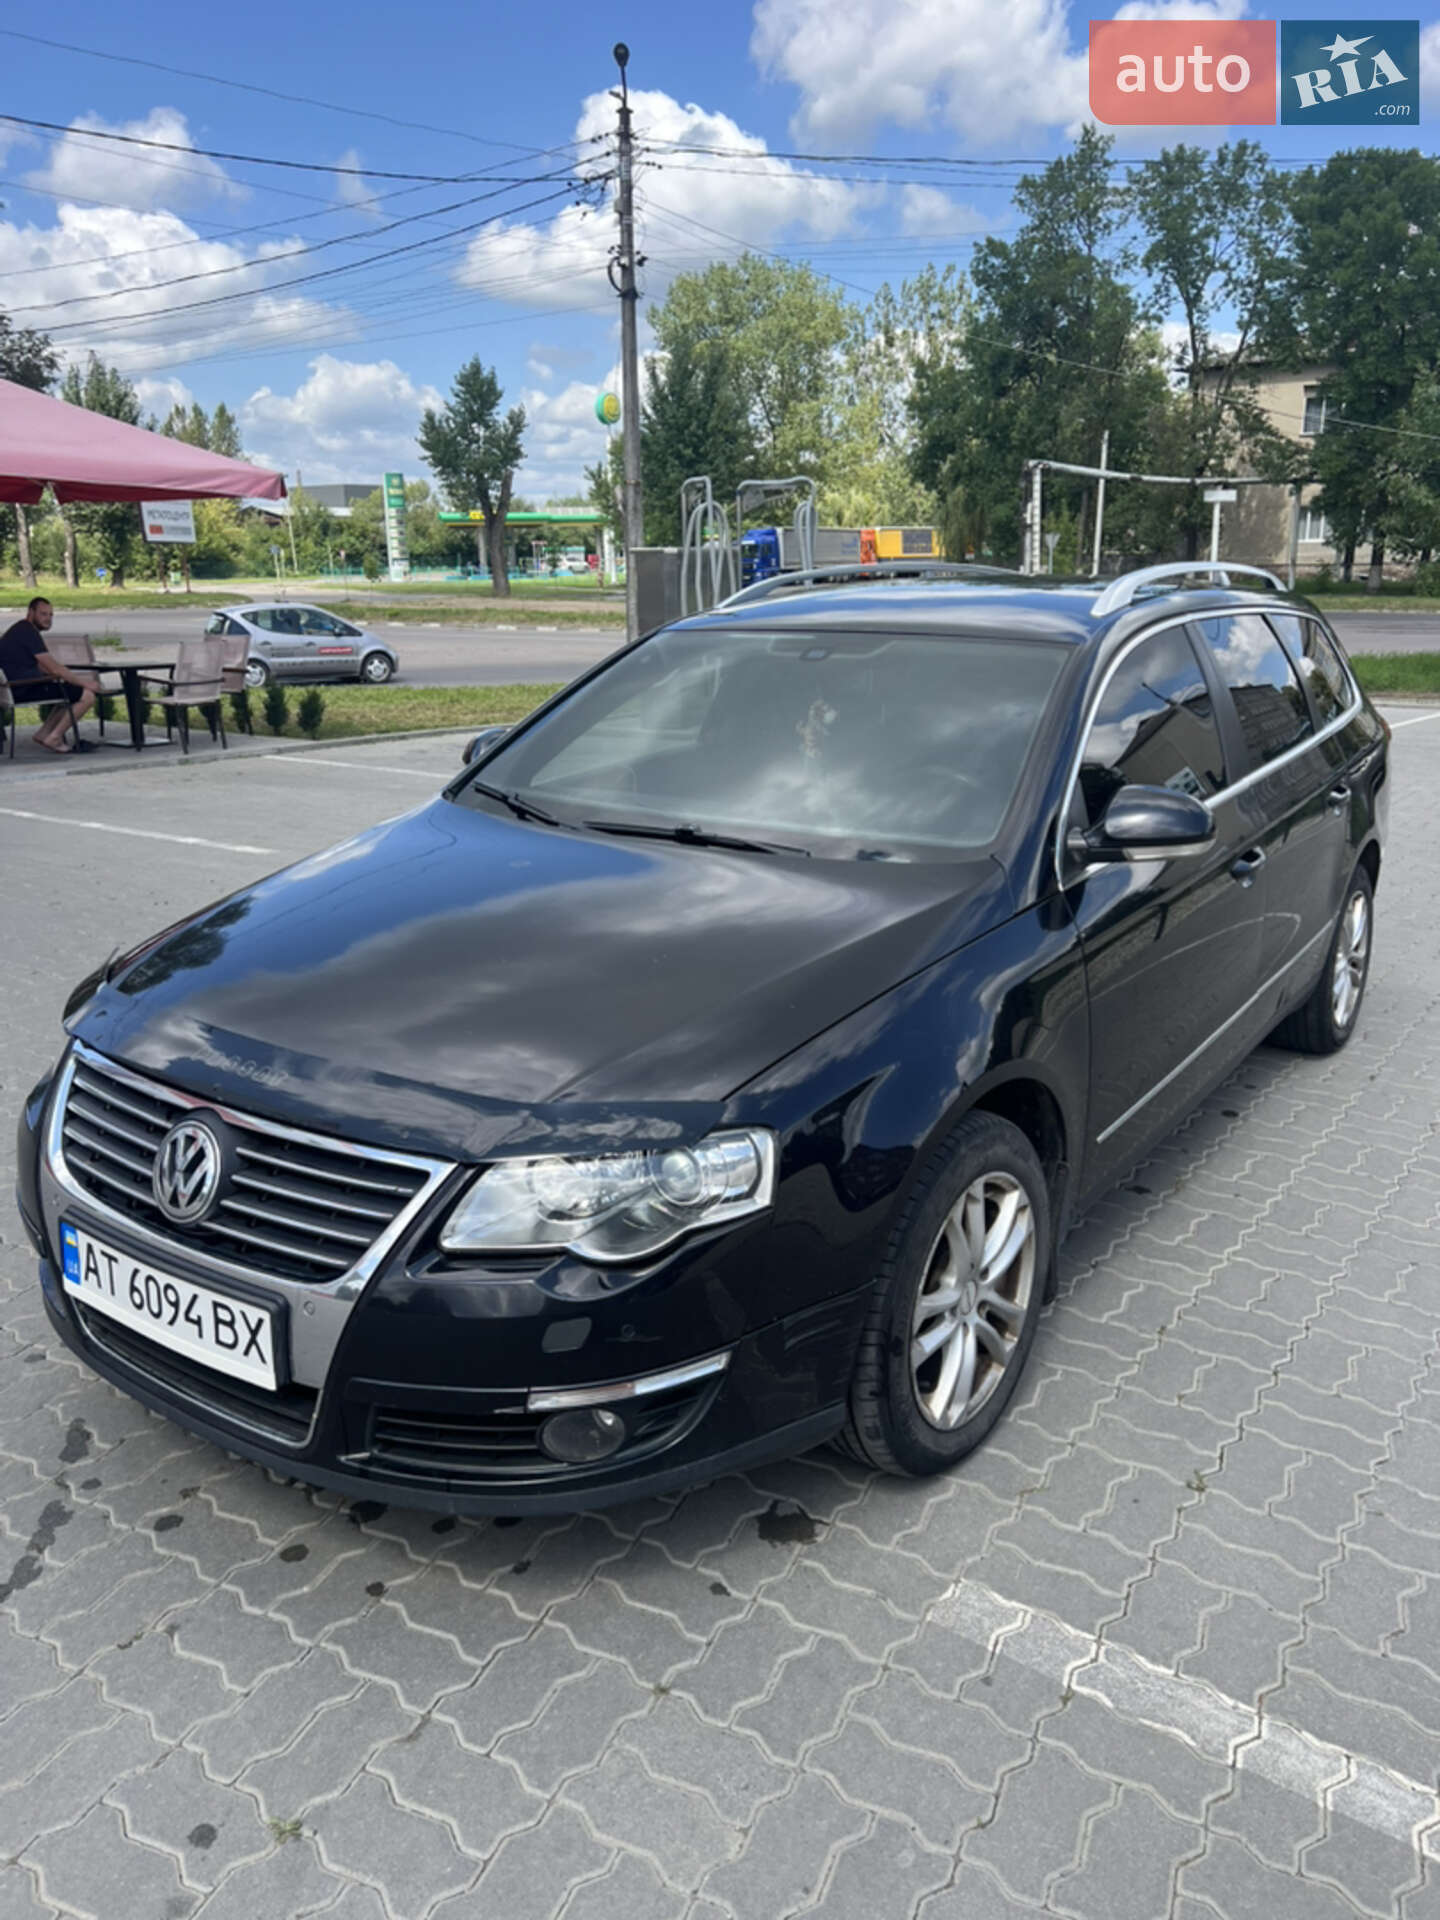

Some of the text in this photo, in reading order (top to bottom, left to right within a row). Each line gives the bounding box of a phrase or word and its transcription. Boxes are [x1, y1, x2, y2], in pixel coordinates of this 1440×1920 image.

[83, 1242, 267, 1365] AT 6094 BX
